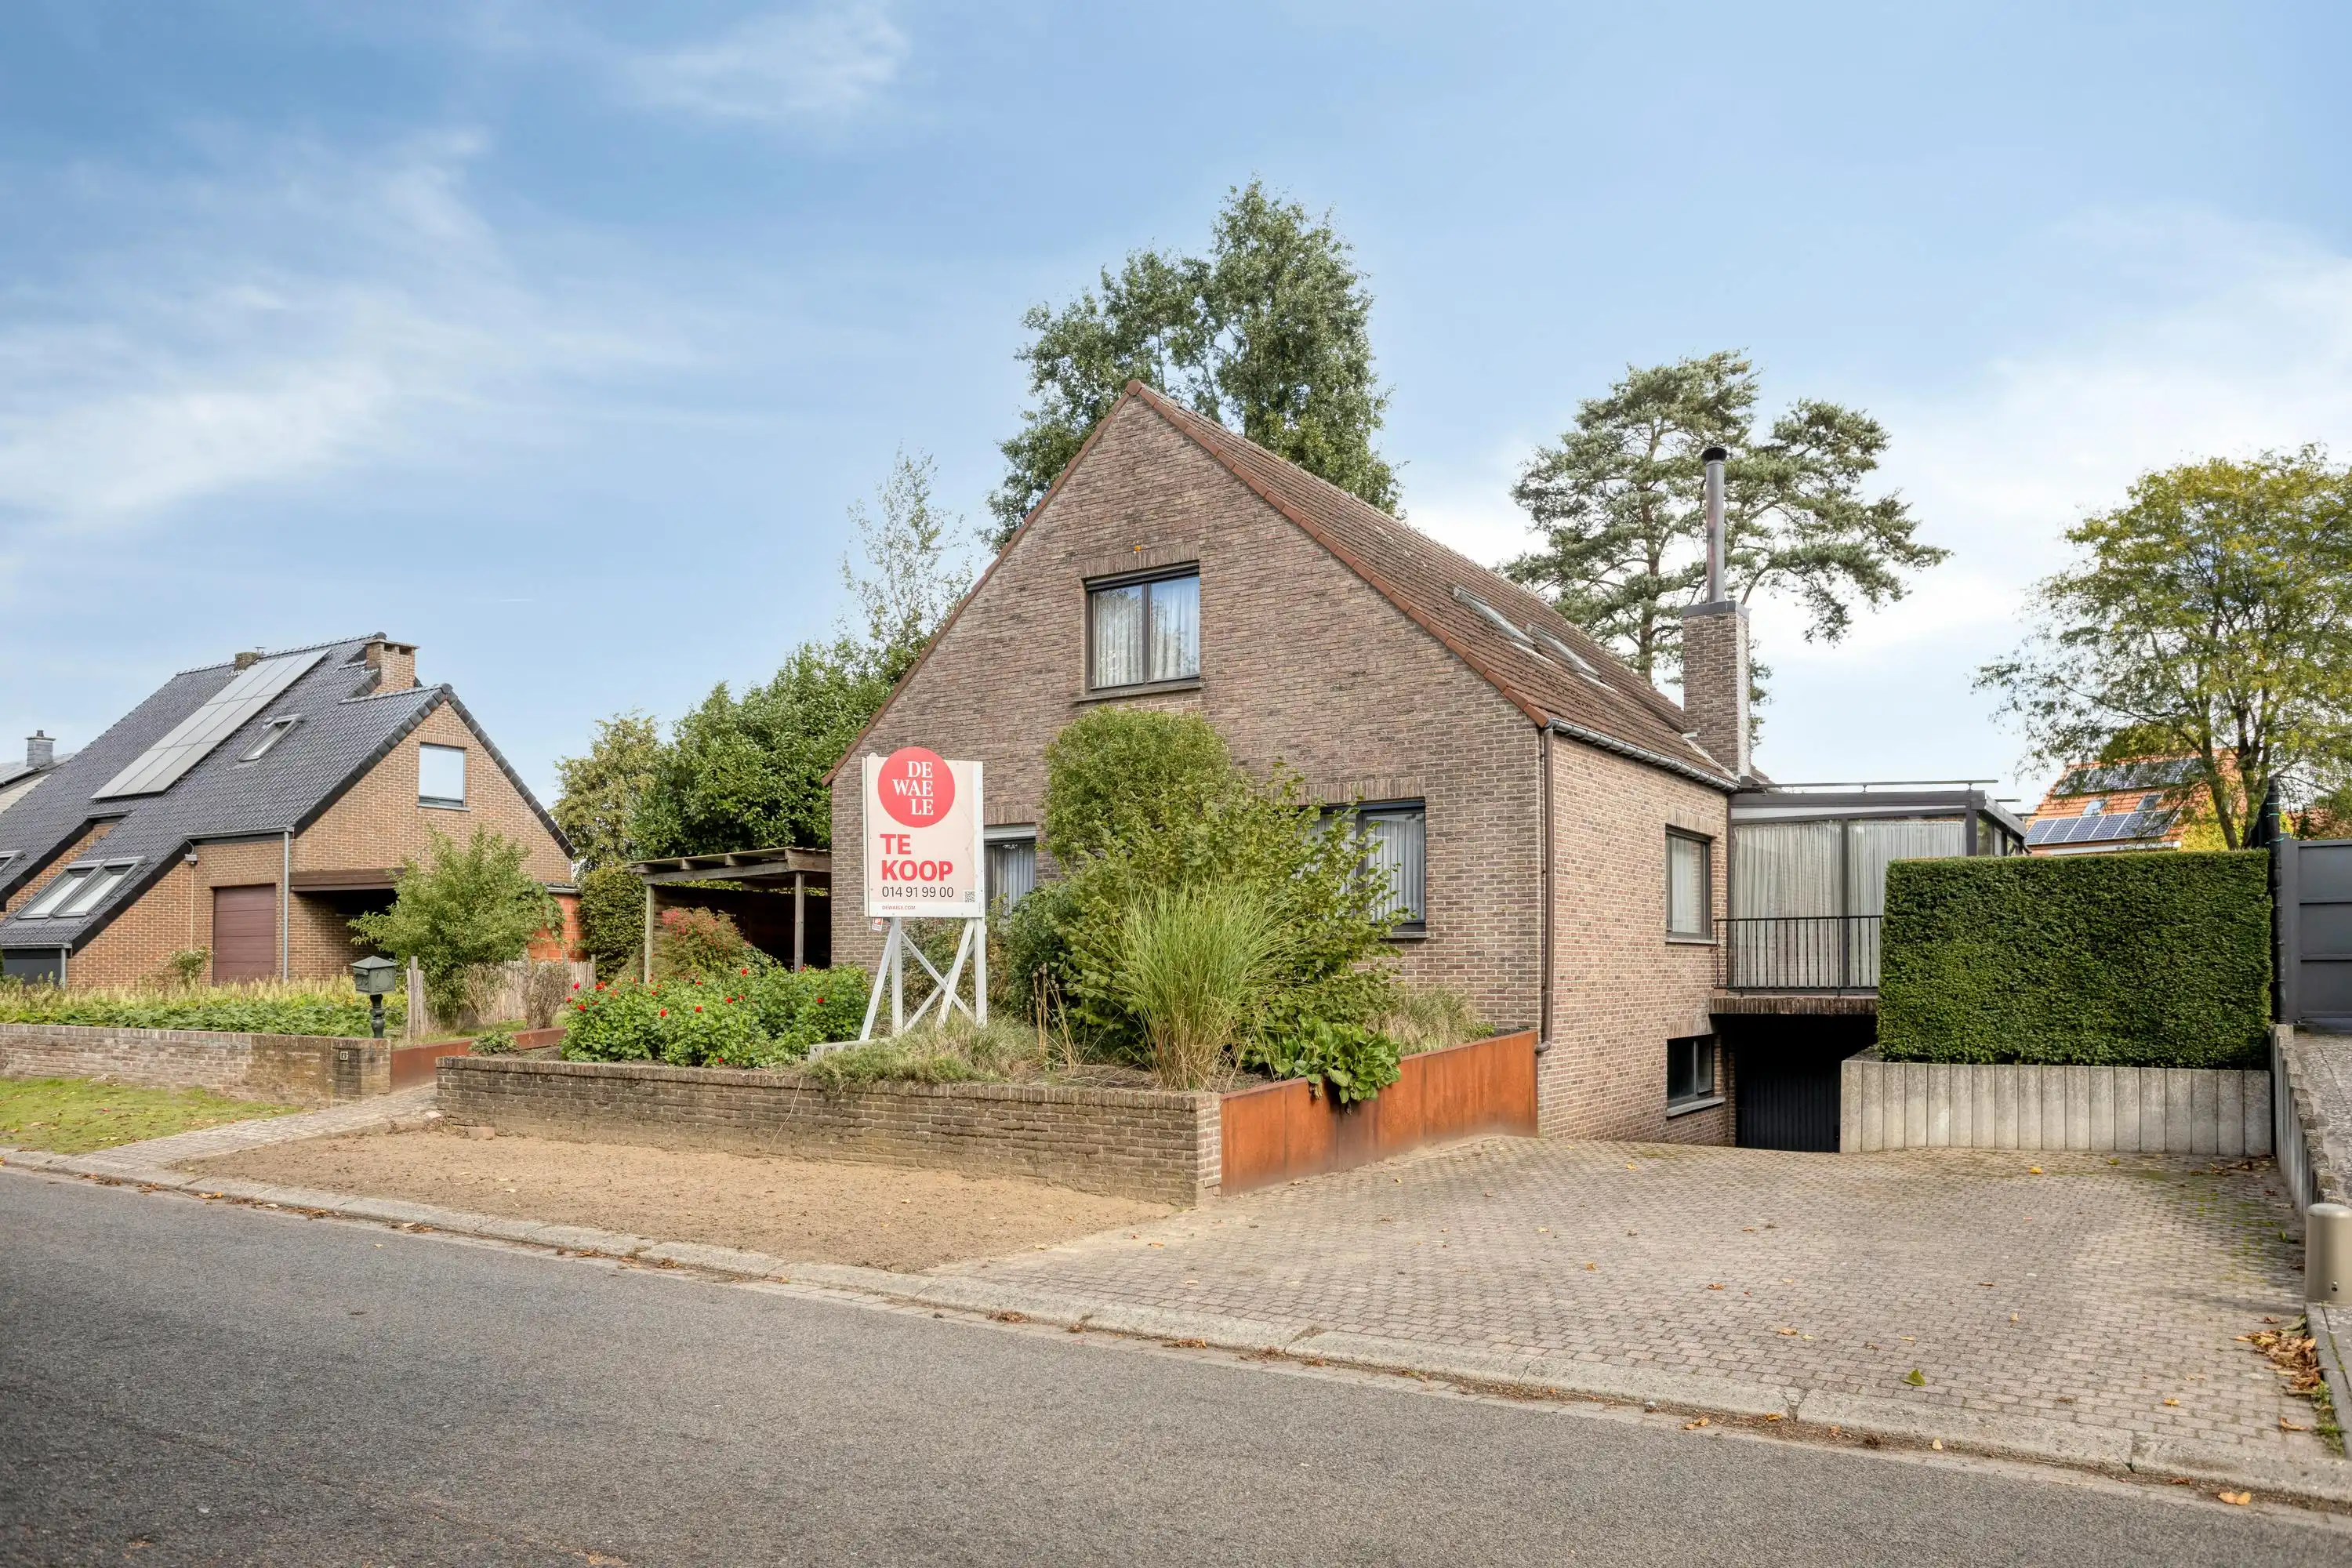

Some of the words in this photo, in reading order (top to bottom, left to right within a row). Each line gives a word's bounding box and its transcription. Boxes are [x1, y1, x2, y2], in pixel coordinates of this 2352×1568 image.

[907, 761, 933, 778] DE
[892, 779, 933, 797] WAE
[911, 799, 934, 815] LE
[880, 833, 912, 855] TE
[881, 860, 953, 881] KOOP
[882, 887, 902, 897] 014
[906, 887, 918, 897] 91
[922, 887, 936, 897] 99
[939, 887, 954, 897] 00
